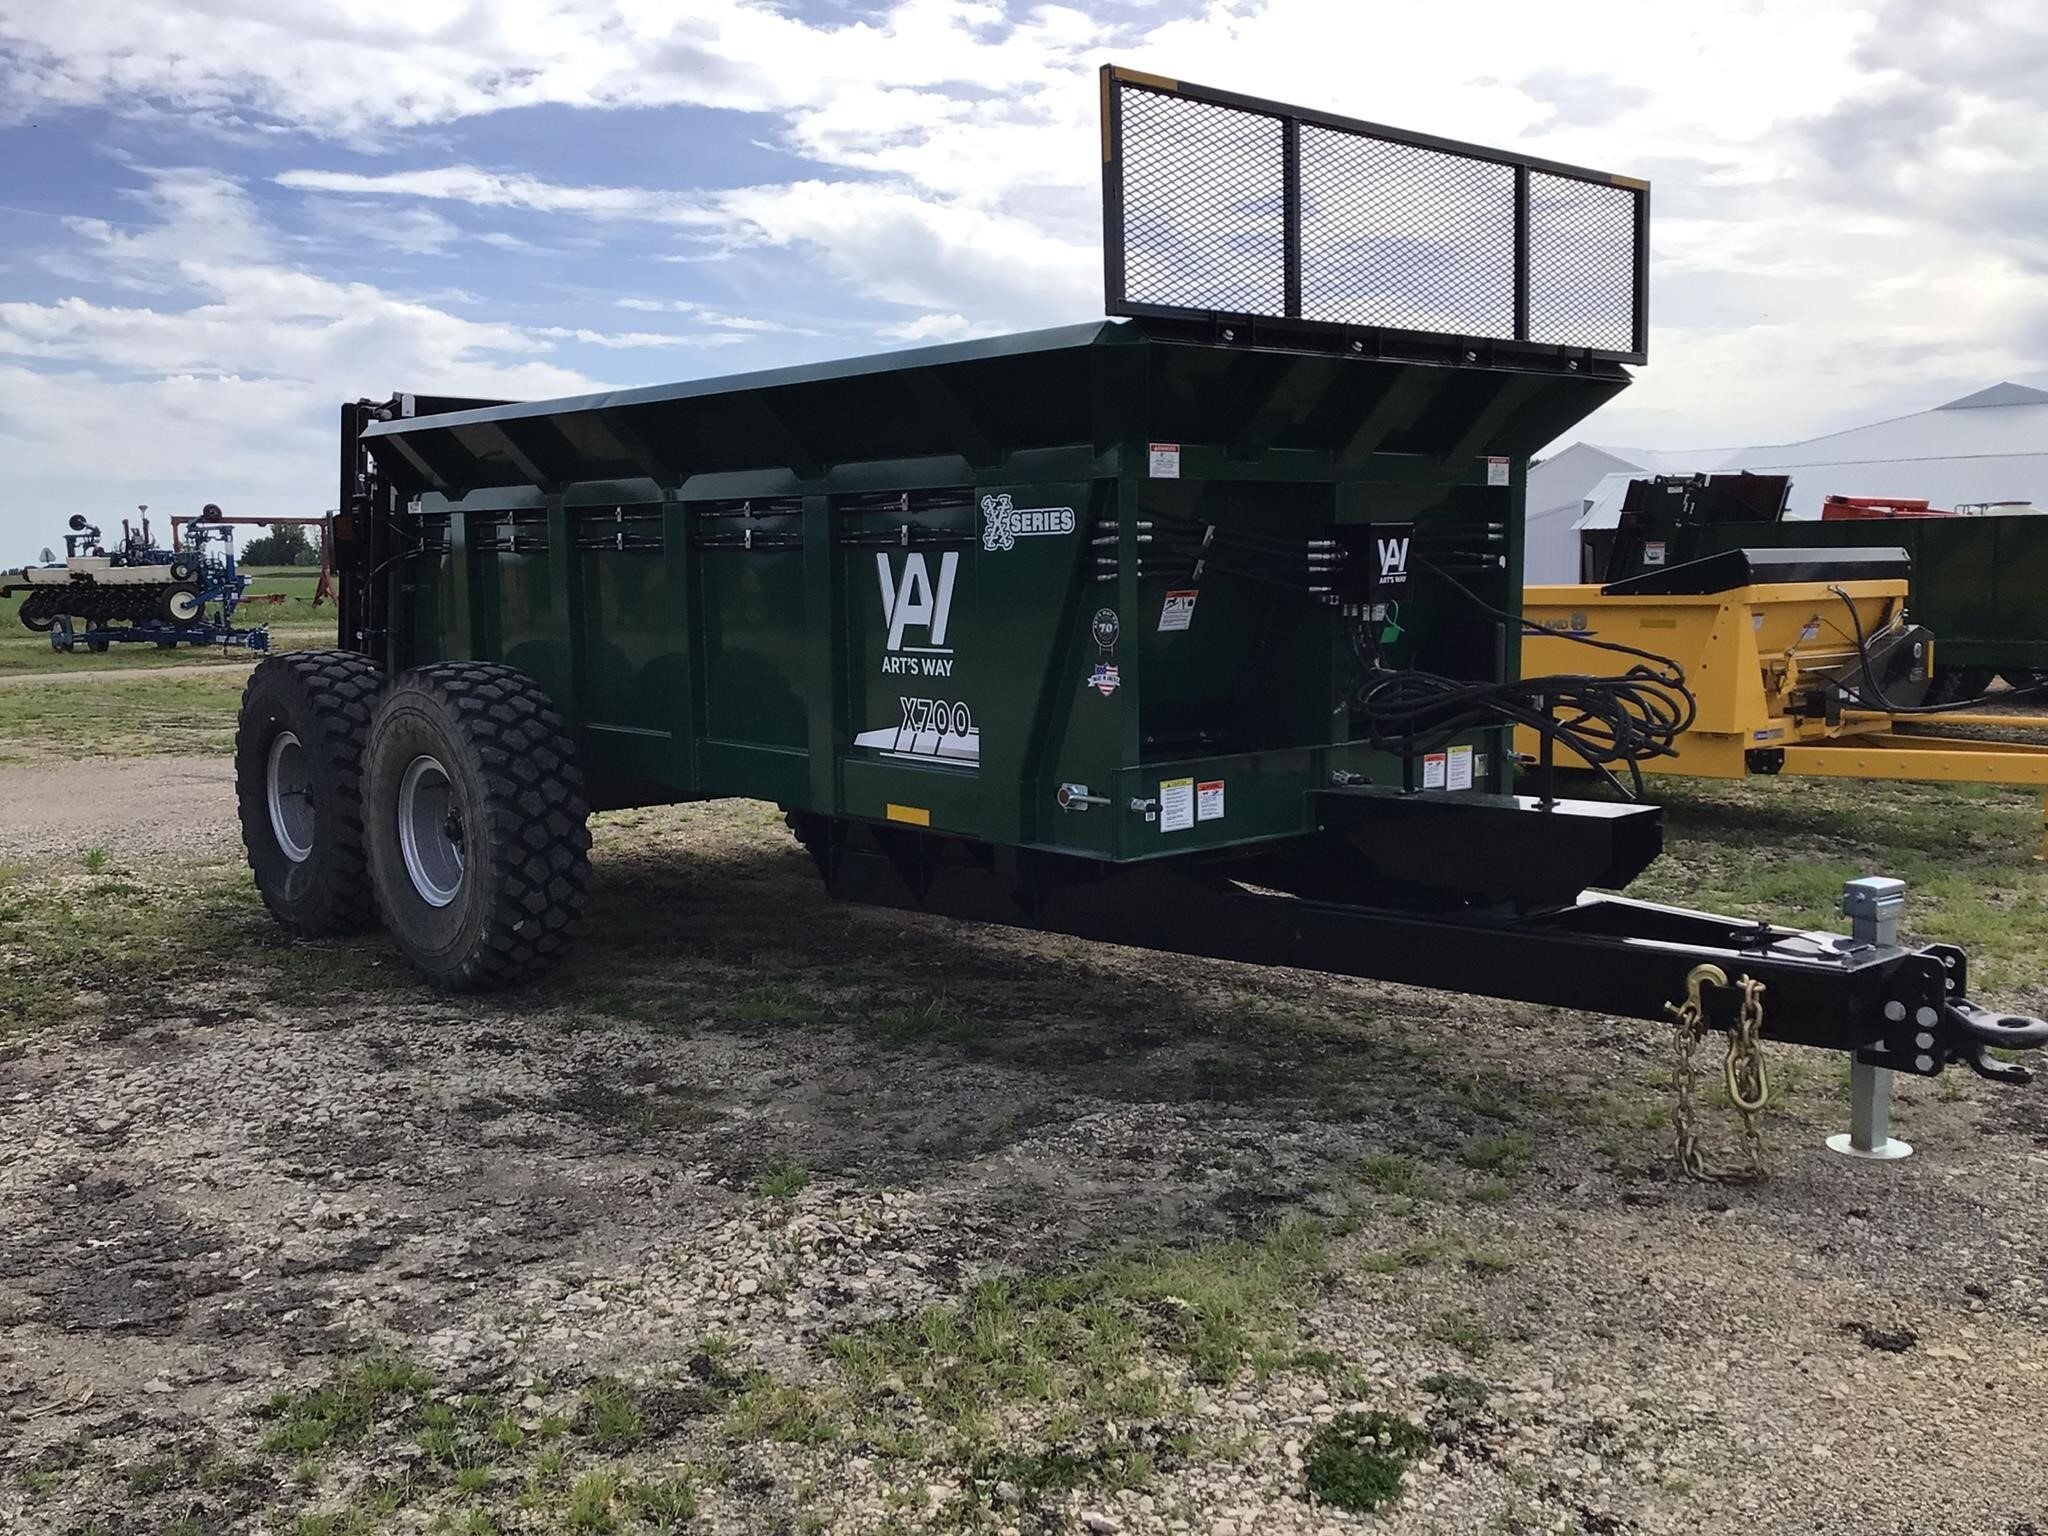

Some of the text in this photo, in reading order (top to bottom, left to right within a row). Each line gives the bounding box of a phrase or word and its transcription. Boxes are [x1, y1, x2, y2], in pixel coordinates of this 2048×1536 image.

[1010, 511, 1073, 532] SERIES
[1099, 623, 1113, 633] 70
[882, 656, 954, 677] ART'S WAY
[900, 696, 971, 738] X700
